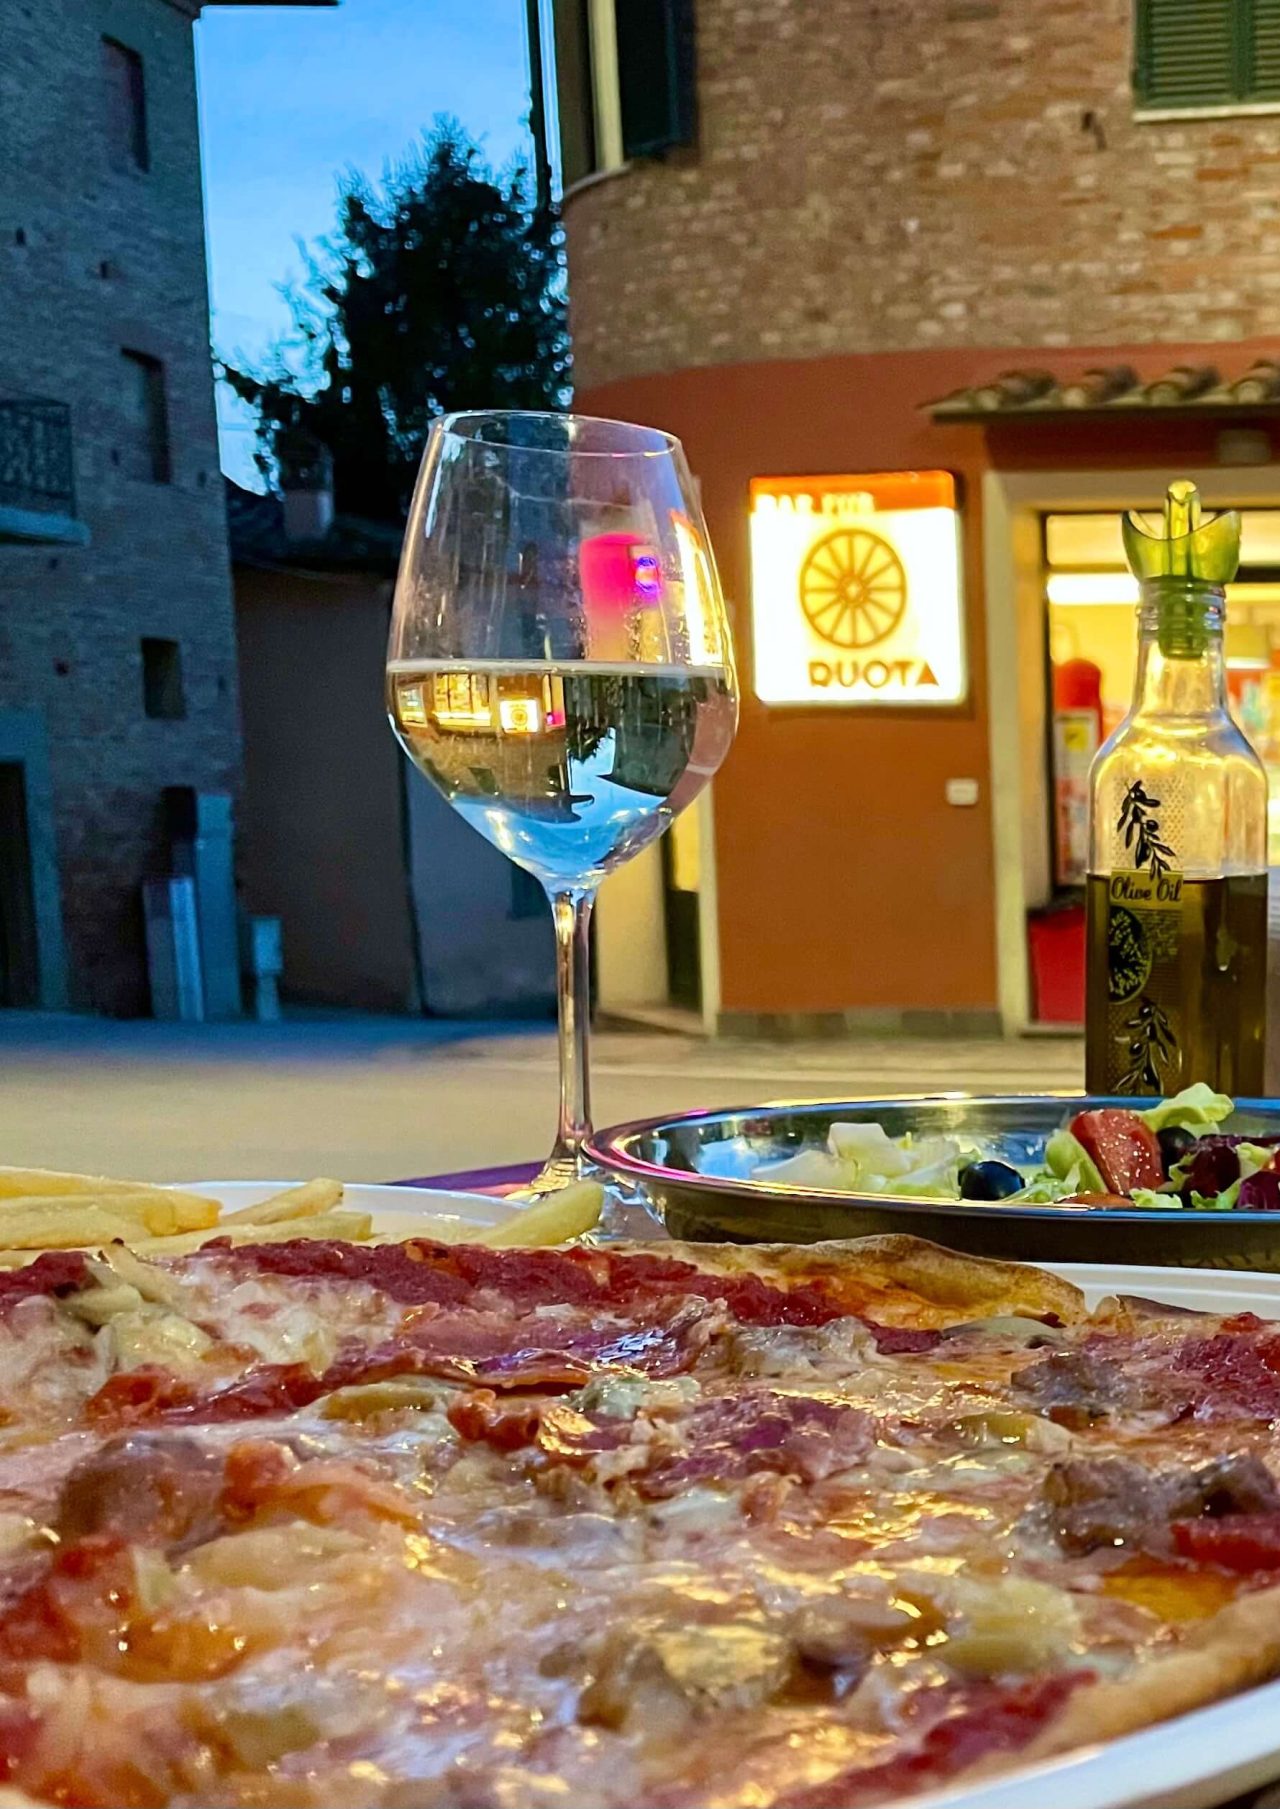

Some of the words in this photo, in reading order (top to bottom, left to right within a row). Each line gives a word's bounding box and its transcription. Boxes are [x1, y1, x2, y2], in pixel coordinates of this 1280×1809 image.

[807, 660, 940, 688] RUOTA
[1110, 875, 1152, 901] Olive
[1156, 878, 1183, 902] Oil
